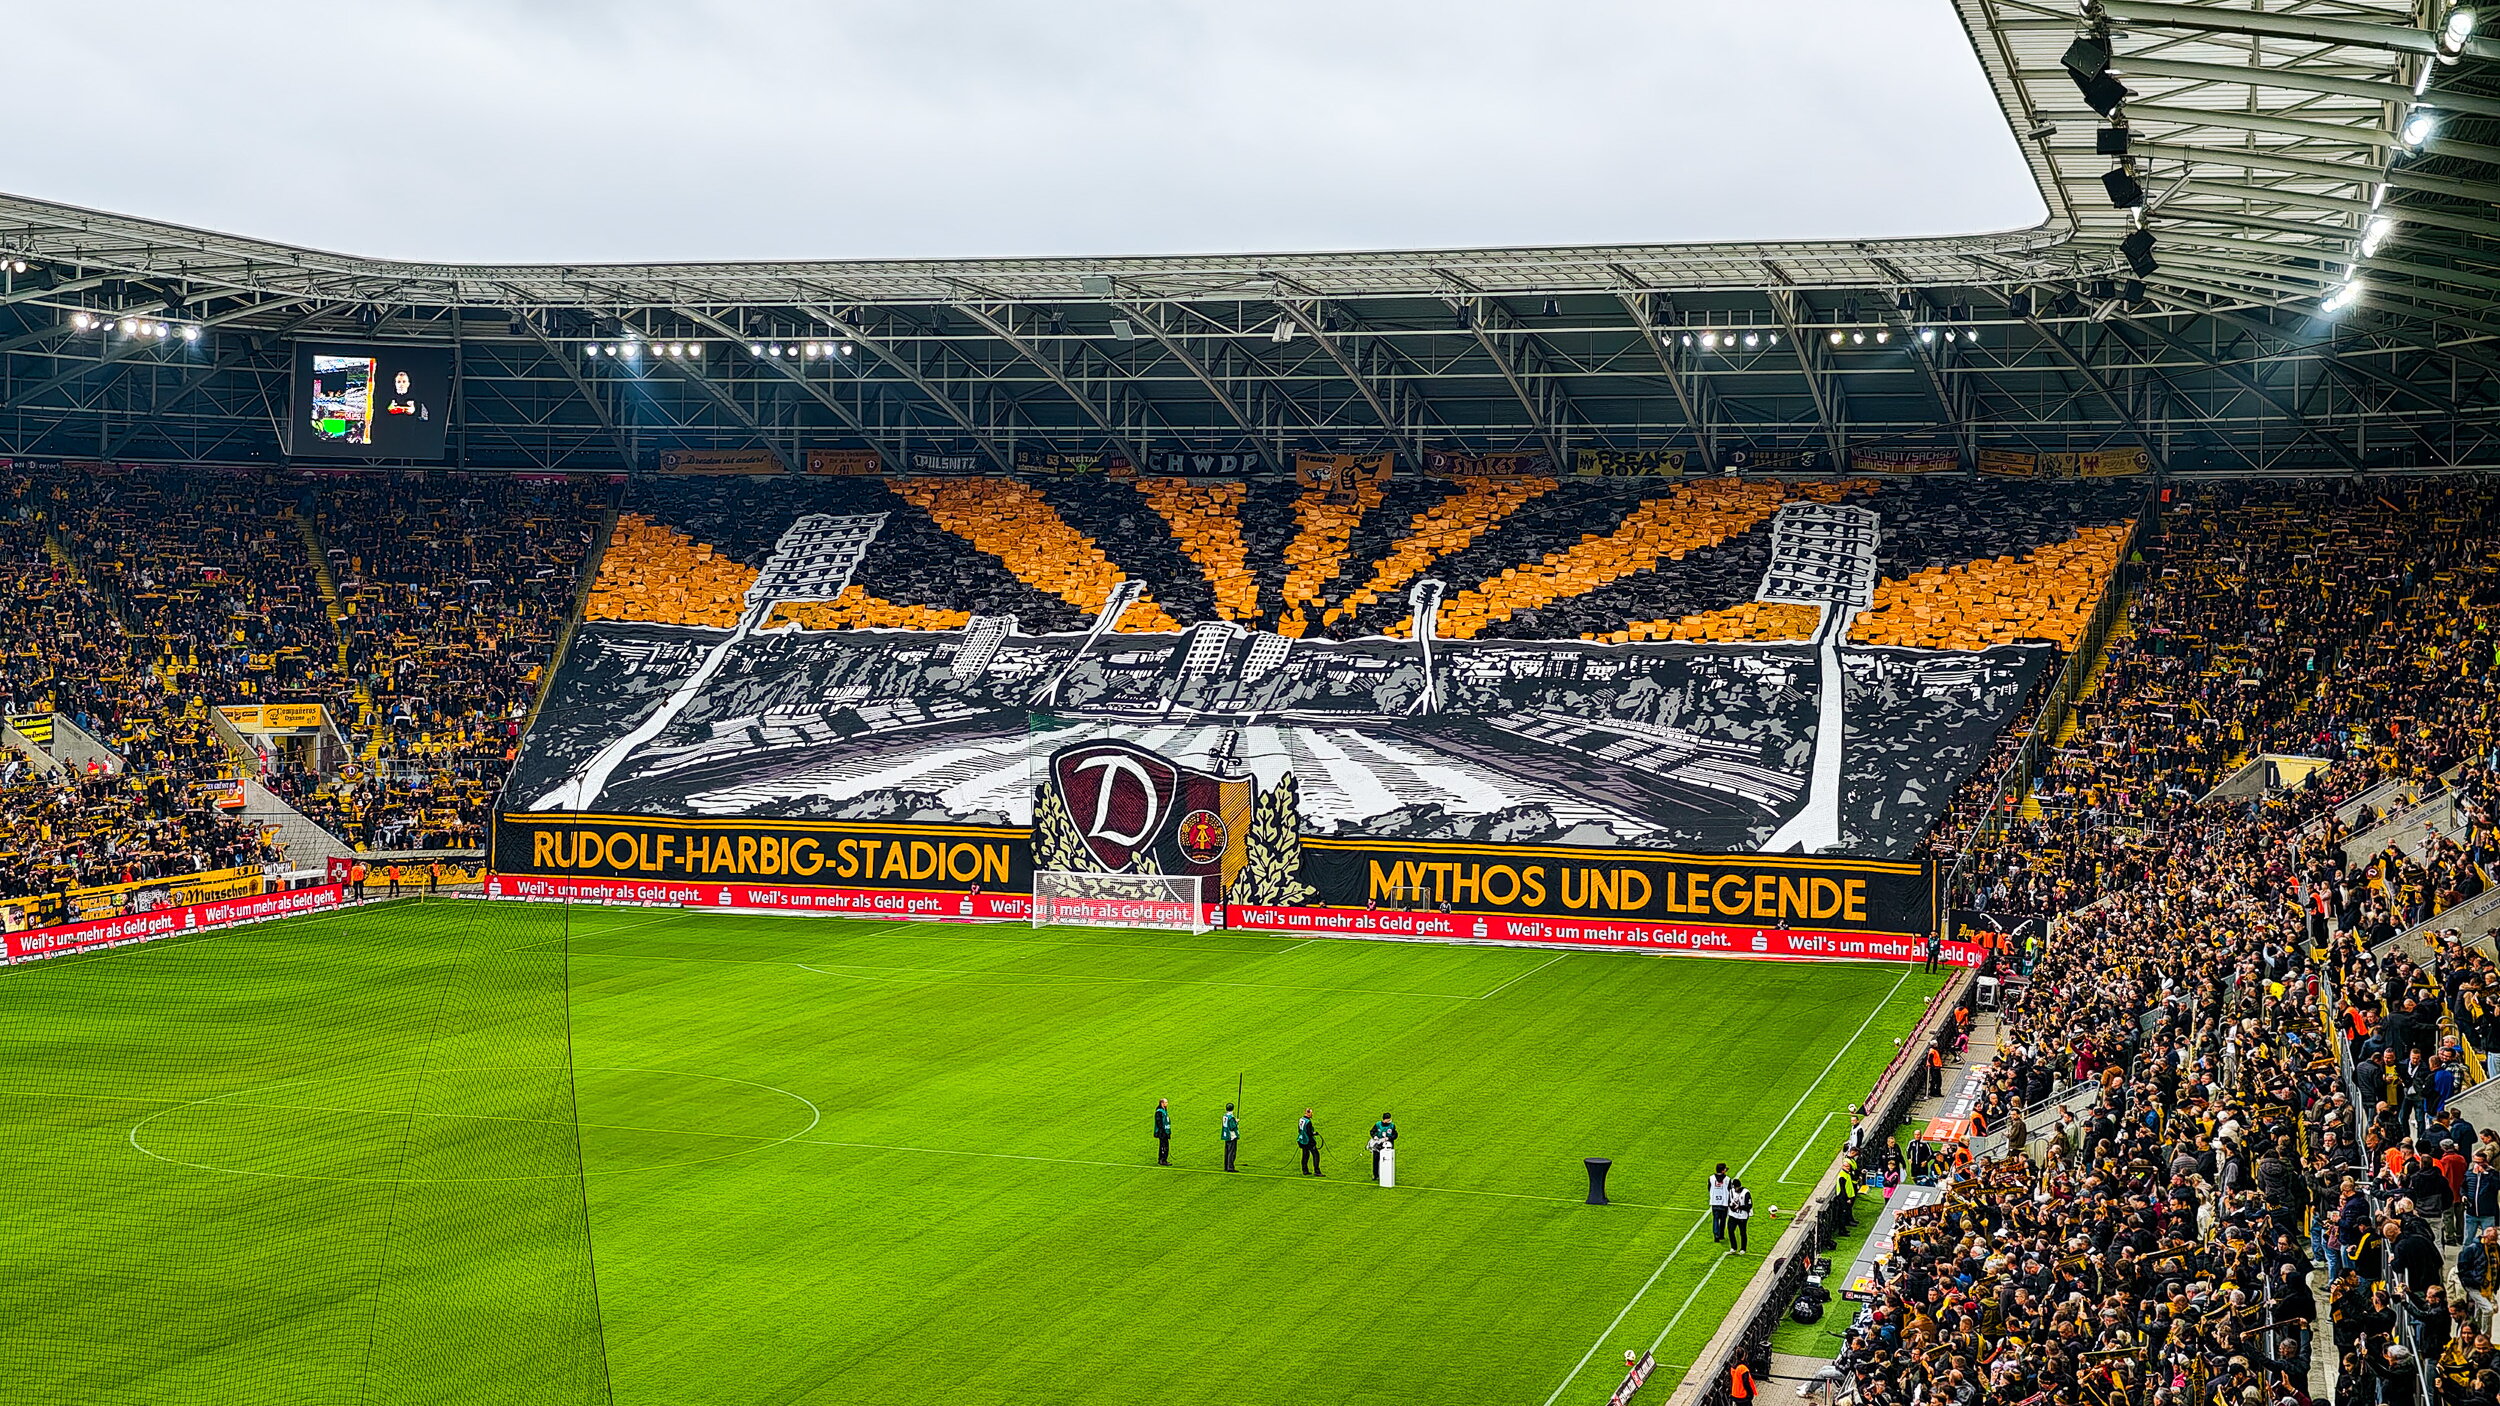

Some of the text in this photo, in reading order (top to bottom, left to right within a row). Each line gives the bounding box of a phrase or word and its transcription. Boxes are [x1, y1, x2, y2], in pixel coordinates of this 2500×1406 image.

[1299, 454, 1336, 463] DYNAMO
[1353, 454, 1385, 464] FANS
[533, 830, 1010, 884] RUDOLF-HARBIG-STADION
[518, 881, 702, 902] Weil's um mehr als Geld geht.
[749, 891, 942, 914] Weil's um mehr als Geld geht.
[1370, 860, 1867, 922] MYTHOS UND LEGENDE
[206, 905, 235, 922] Weil's
[237, 907, 251, 917] um
[253, 899, 277, 915] mehr
[279, 897, 291, 910] als
[293, 893, 313, 908] Geld
[314, 890, 336, 906] geht.
[991, 899, 1032, 915] Weil's
[1060, 904, 1096, 917] mehr
[1099, 904, 1119, 918] als
[1122, 905, 1152, 919] Geld
[1156, 907, 1192, 922] geht.
[20, 932, 54, 951] Weil's
[76, 929, 105, 943] mehr
[107, 925, 122, 938] als
[123, 918, 147, 935] Geld
[148, 915, 175, 934] geht.
[1241, 909, 1454, 934] Weil's um mehr als Geld geht.
[1507, 921, 1732, 949] Weil's um mehr als Geld geht.
[1788, 936, 1836, 952] Weil's
[1841, 942, 1864, 953] um
[1870, 941, 1909, 956] mehr
